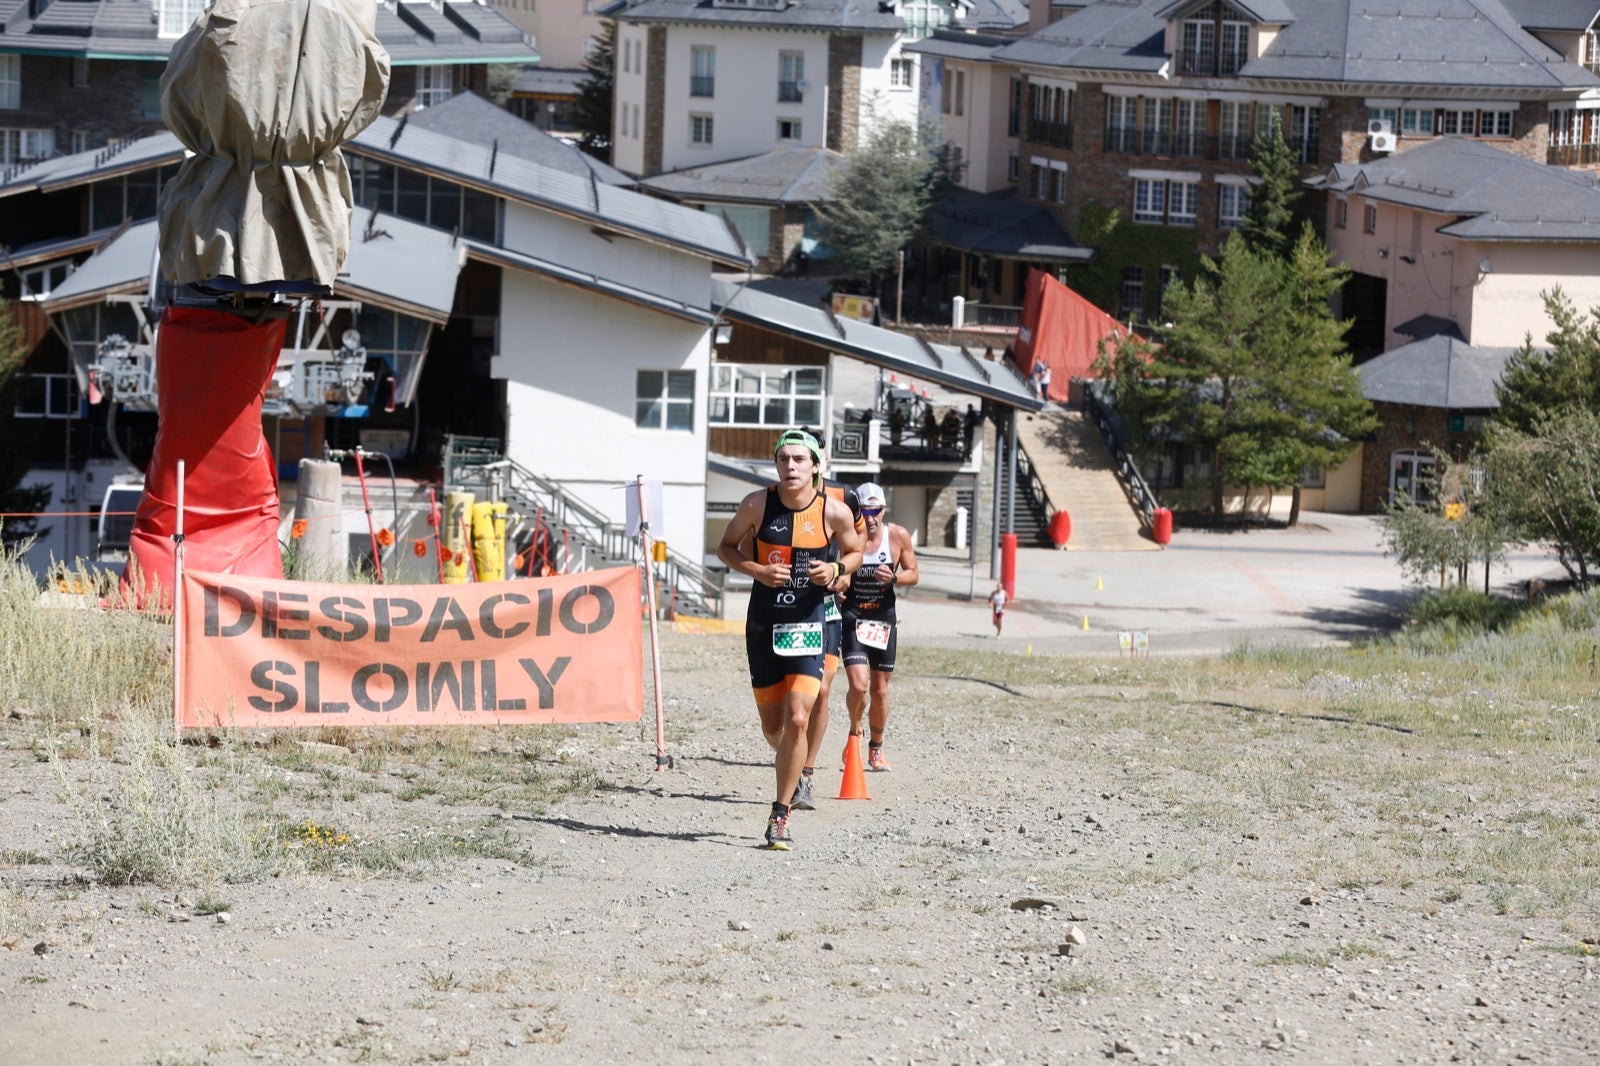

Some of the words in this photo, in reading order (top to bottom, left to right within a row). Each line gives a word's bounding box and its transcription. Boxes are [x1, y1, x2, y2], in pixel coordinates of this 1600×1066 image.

[203, 584, 615, 643] DESPACIO
[792, 633, 804, 647] 2
[247, 656, 573, 713] SLOWLY
